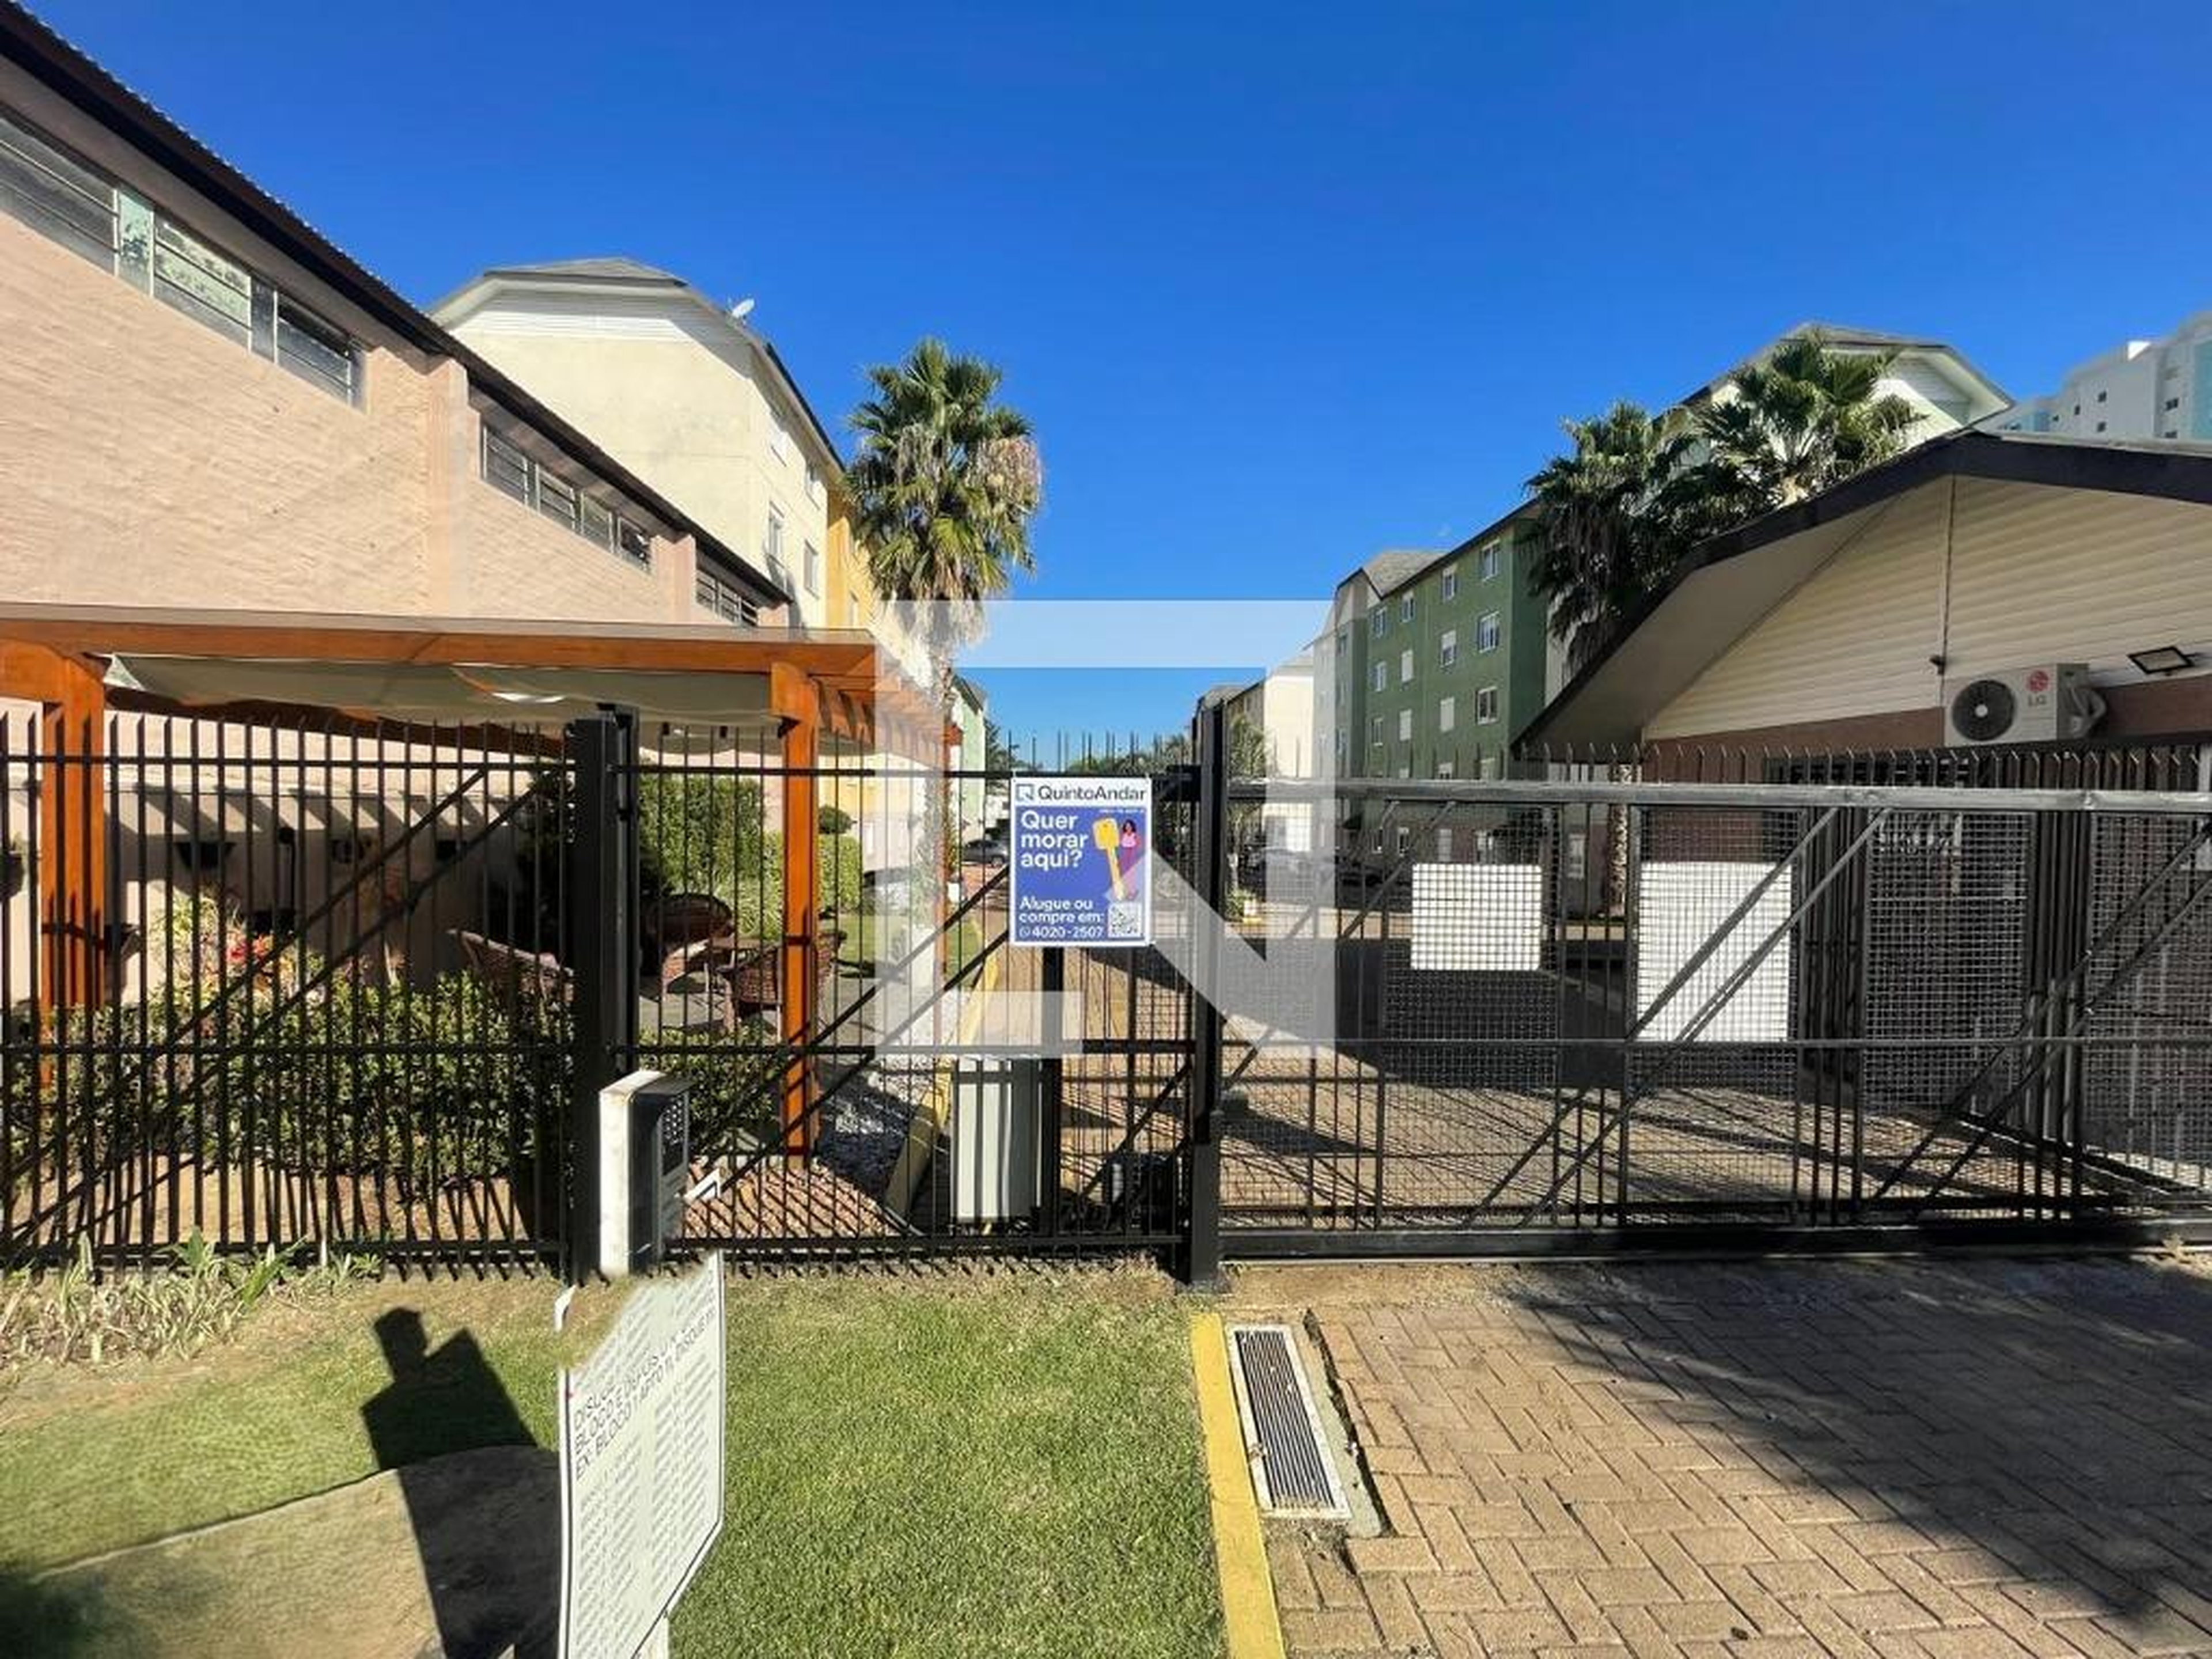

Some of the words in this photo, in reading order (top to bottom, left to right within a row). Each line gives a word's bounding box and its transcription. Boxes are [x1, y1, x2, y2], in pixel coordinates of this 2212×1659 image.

[2027, 695, 2047, 707] LG
[1038, 786, 1146, 800] QuintoAndar
[1021, 810, 1078, 830] Quer
[1021, 833, 1088, 849] morar
[1020, 849, 1083, 871] aqui?
[1019, 896, 1072, 911] Alugue
[1074, 899, 1093, 910] ou
[1018, 912, 1075, 925] compre
[1078, 912, 1104, 923] em:
